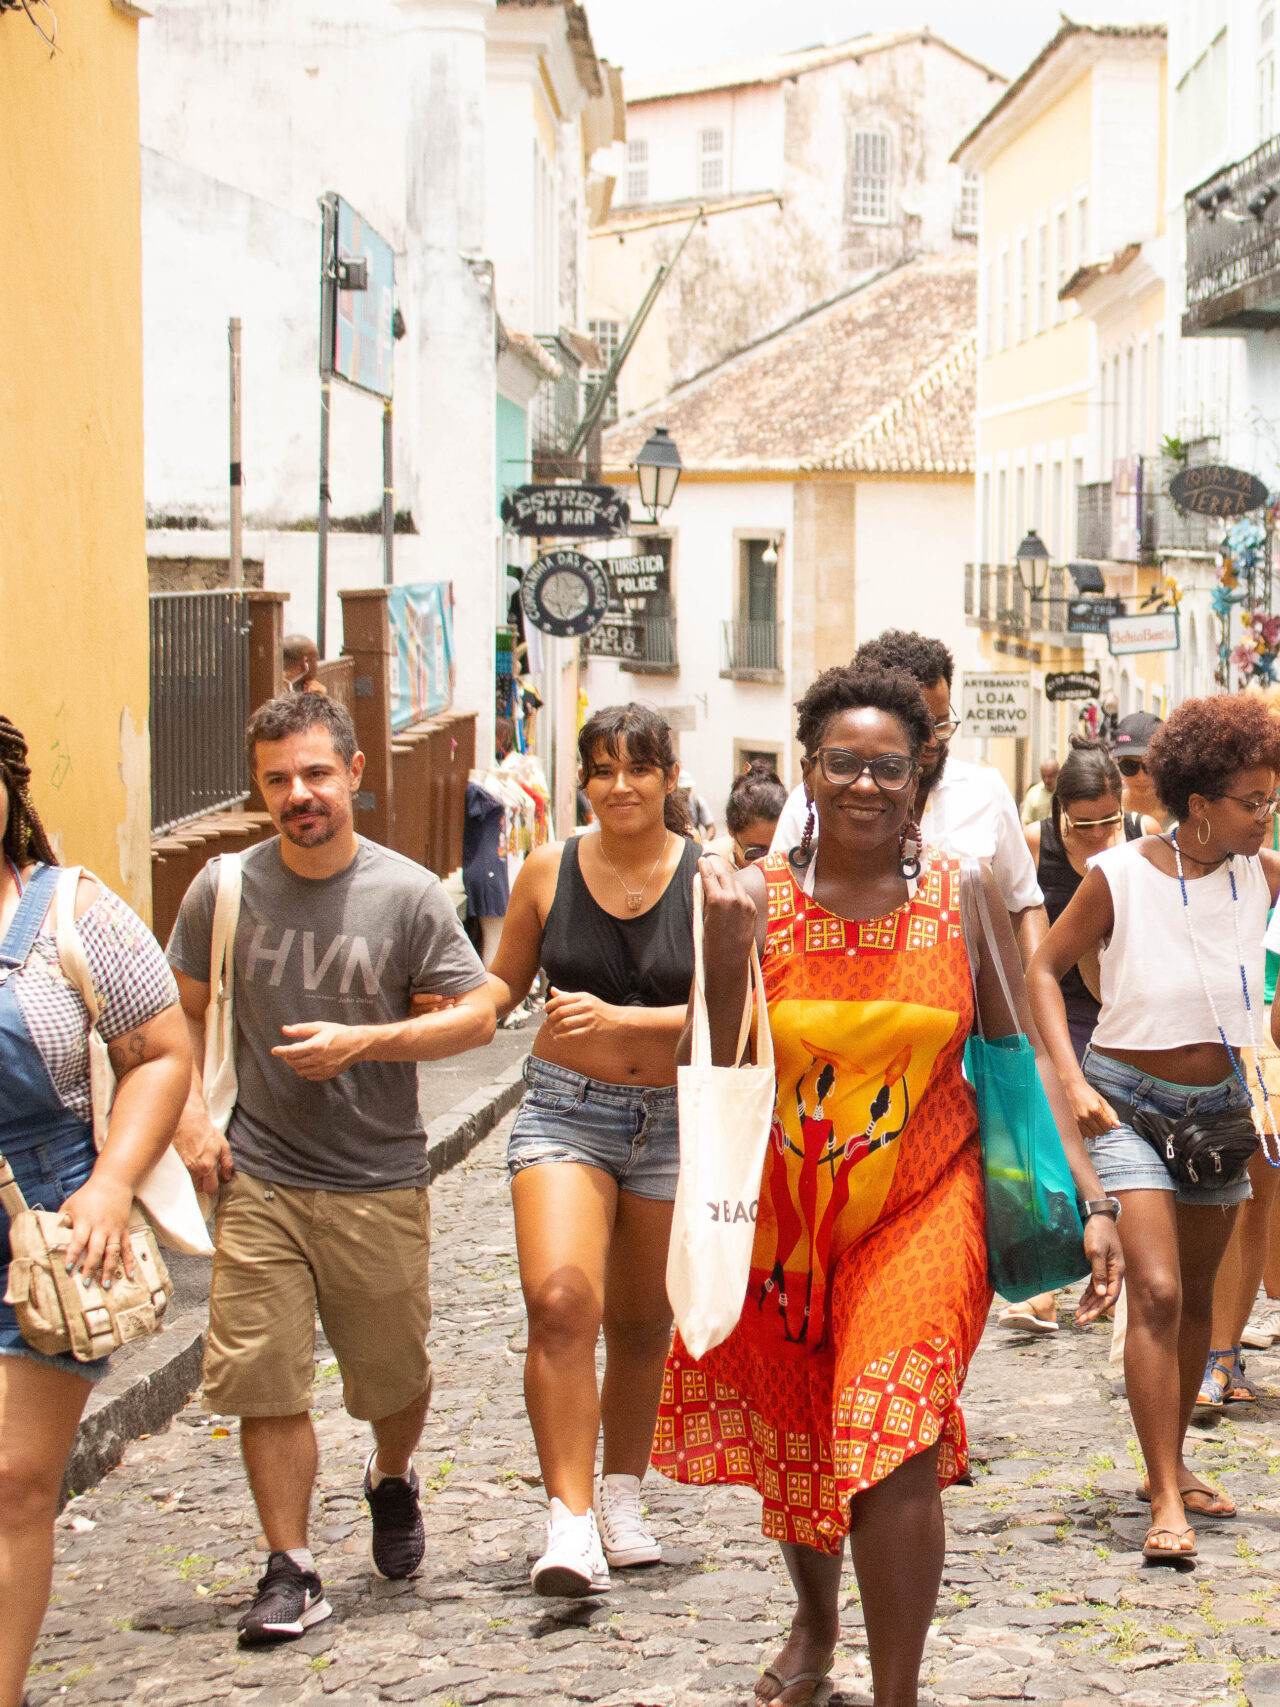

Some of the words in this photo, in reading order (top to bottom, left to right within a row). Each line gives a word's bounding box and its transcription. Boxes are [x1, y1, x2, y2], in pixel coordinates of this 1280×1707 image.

[515, 489, 618, 523] ESTRELA
[1189, 490, 1247, 513] TERRA
[536, 510, 557, 525] DO
[561, 509, 595, 525] MAR
[557, 553, 581, 568] DAS
[617, 576, 657, 593] POLICE
[964, 680, 1029, 688] ARTESANATO
[976, 692, 1015, 704] LOJA
[966, 708, 1027, 720] ACERVO
[245, 925, 394, 995] HVN
